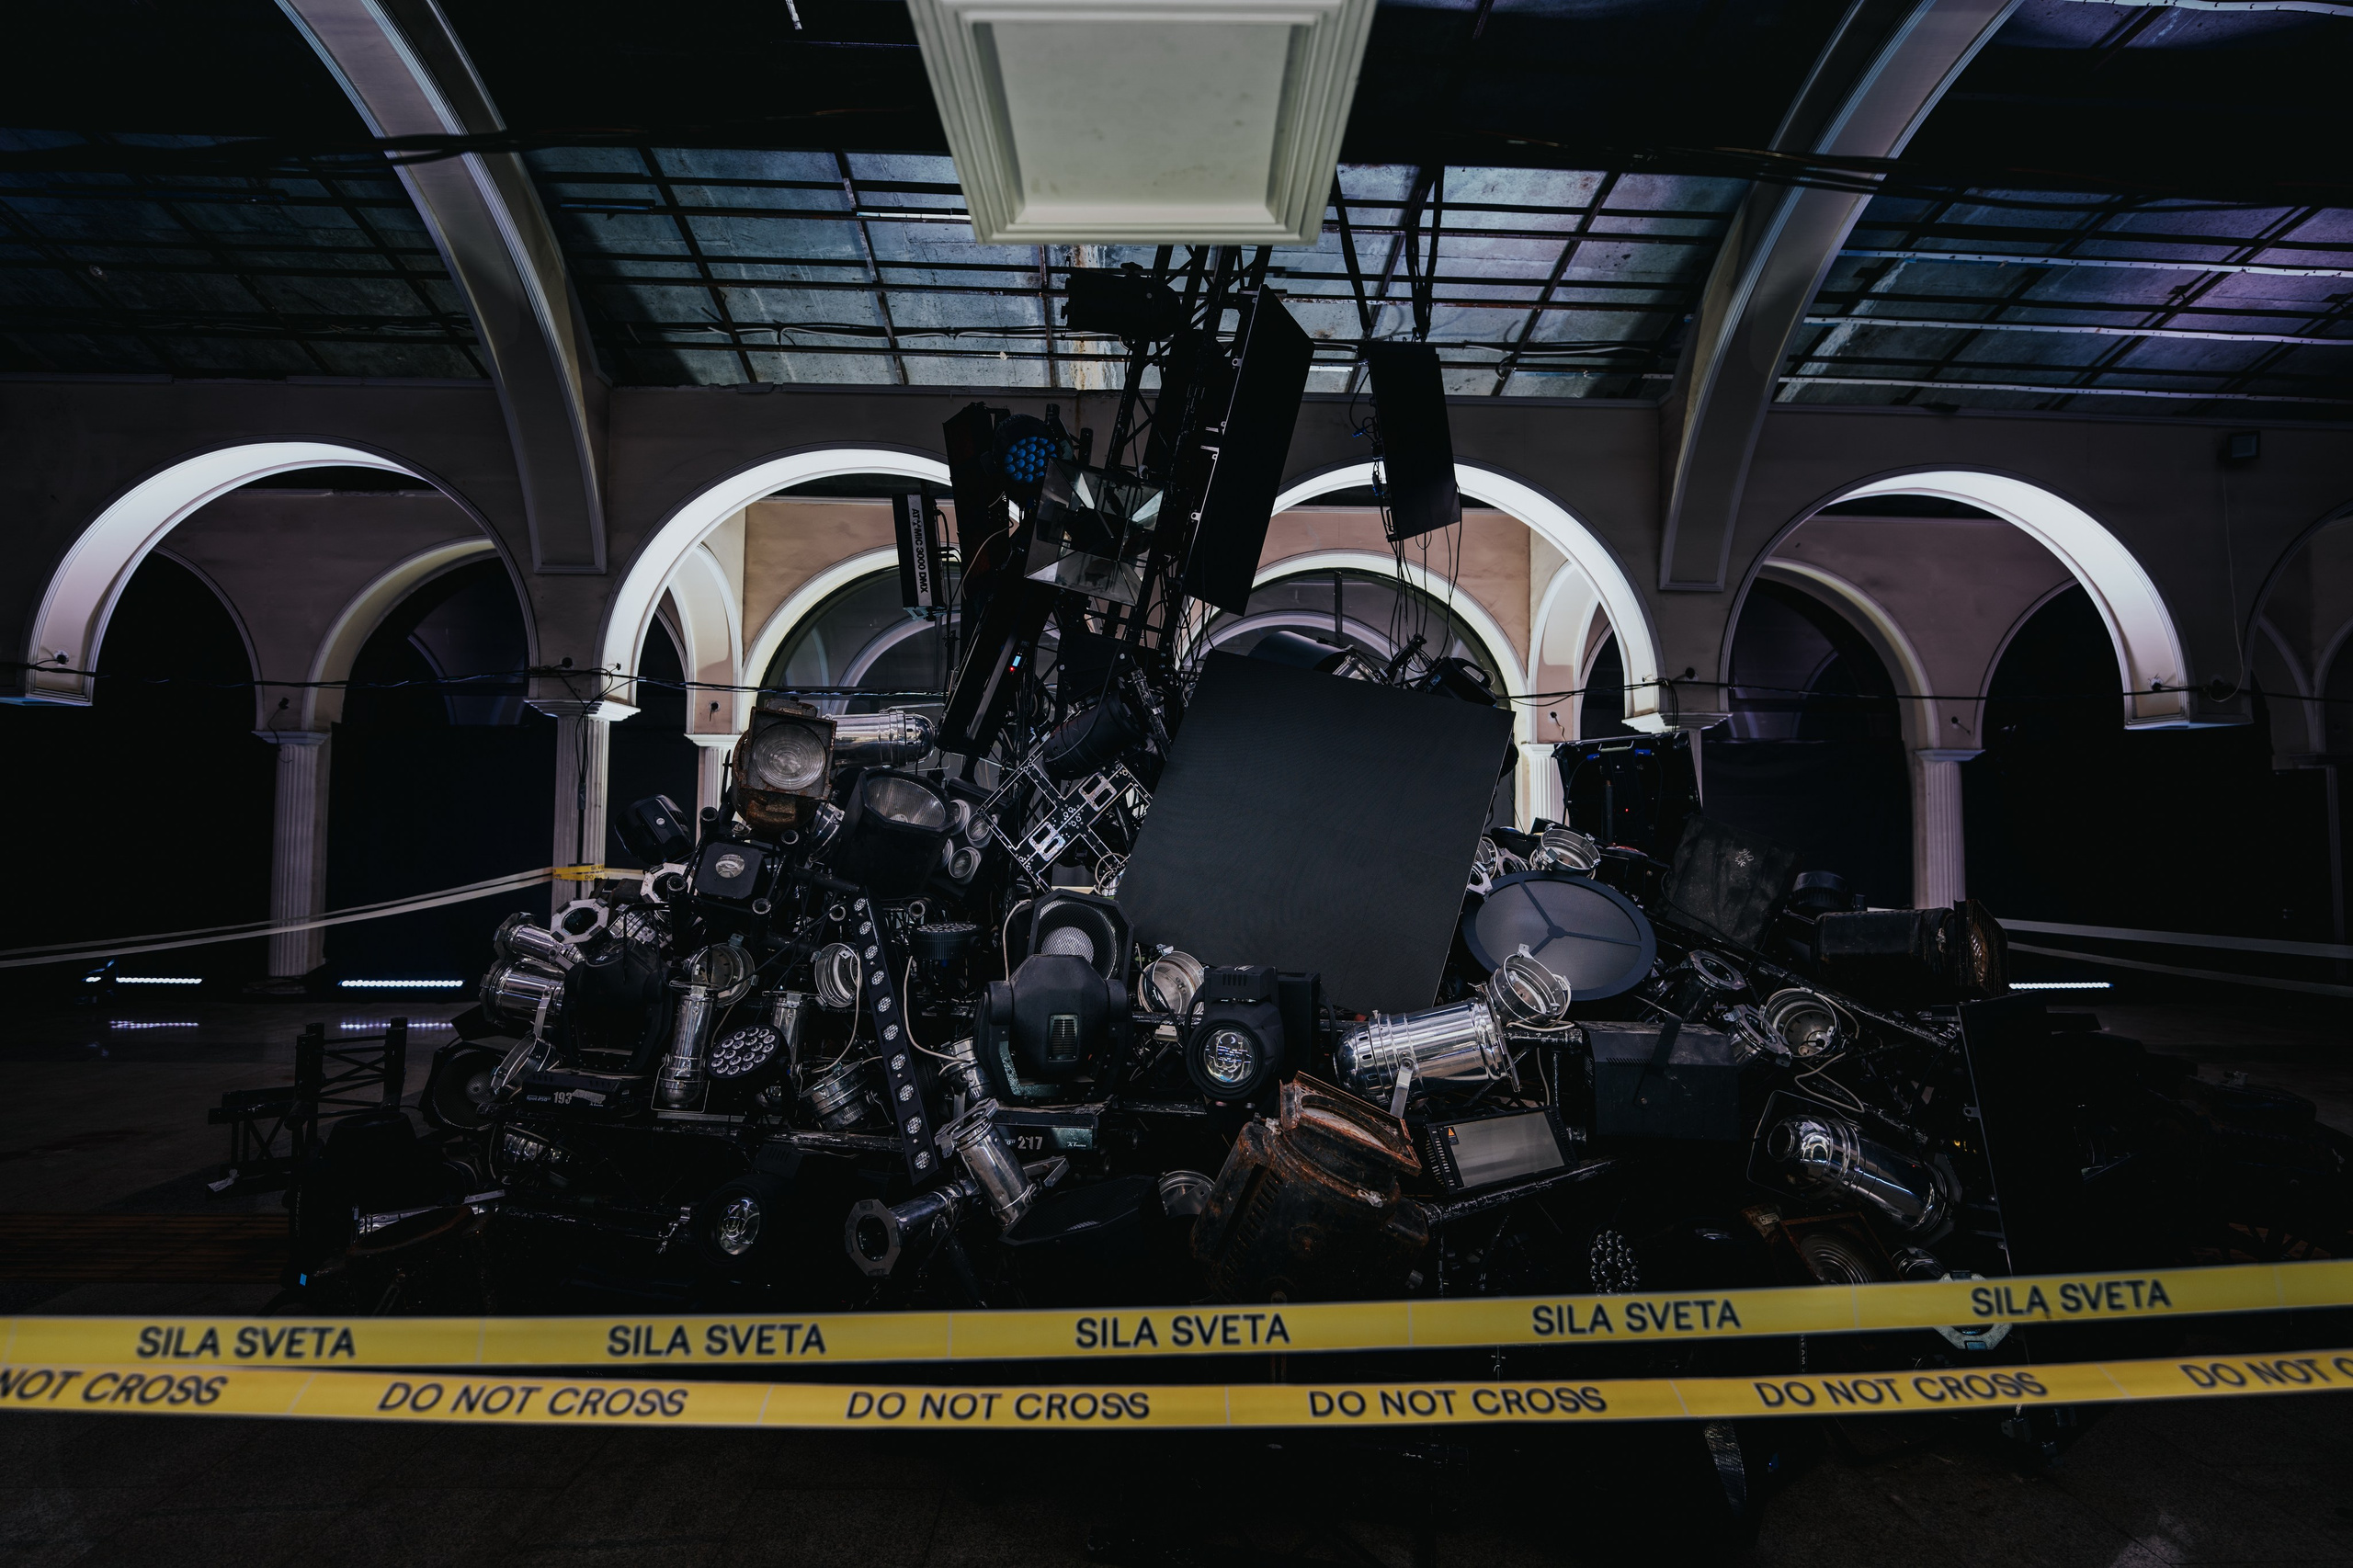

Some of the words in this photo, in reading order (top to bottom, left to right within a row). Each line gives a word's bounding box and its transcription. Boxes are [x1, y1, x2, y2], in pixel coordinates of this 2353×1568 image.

[915, 547, 926, 570] 3000
[918, 572, 928, 593] DMX
[553, 1091, 573, 1105] 193
[1017, 1135, 1043, 1150] 217
[1972, 1283, 2051, 1316] SILA
[2058, 1277, 2171, 1310] SVETA
[1075, 1316, 1160, 1350] SILA
[1171, 1313, 1290, 1347] SVETA
[1532, 1303, 1614, 1336] SILA
[1625, 1299, 1744, 1334] SVETA
[136, 1325, 222, 1359] SILA
[233, 1326, 357, 1360] SVETA
[607, 1324, 692, 1358] SILA
[704, 1323, 827, 1358] SVETA
[82, 1372, 228, 1405] CROSS
[1753, 1381, 1816, 1408] DO
[1823, 1379, 1904, 1406] NOT
[1913, 1372, 2049, 1403] CROSS
[2179, 1363, 2246, 1389] DO
[2243, 1358, 2332, 1385] NOT
[378, 1382, 443, 1412] DO
[451, 1385, 542, 1415] NOT
[549, 1388, 688, 1416] CROSS
[847, 1392, 906, 1420] DO
[920, 1393, 1002, 1420] NOT
[1015, 1392, 1151, 1421] CROSS
[1309, 1391, 1366, 1417] DO
[1380, 1390, 1457, 1416] NOT
[1472, 1386, 1608, 1415] CROSS
